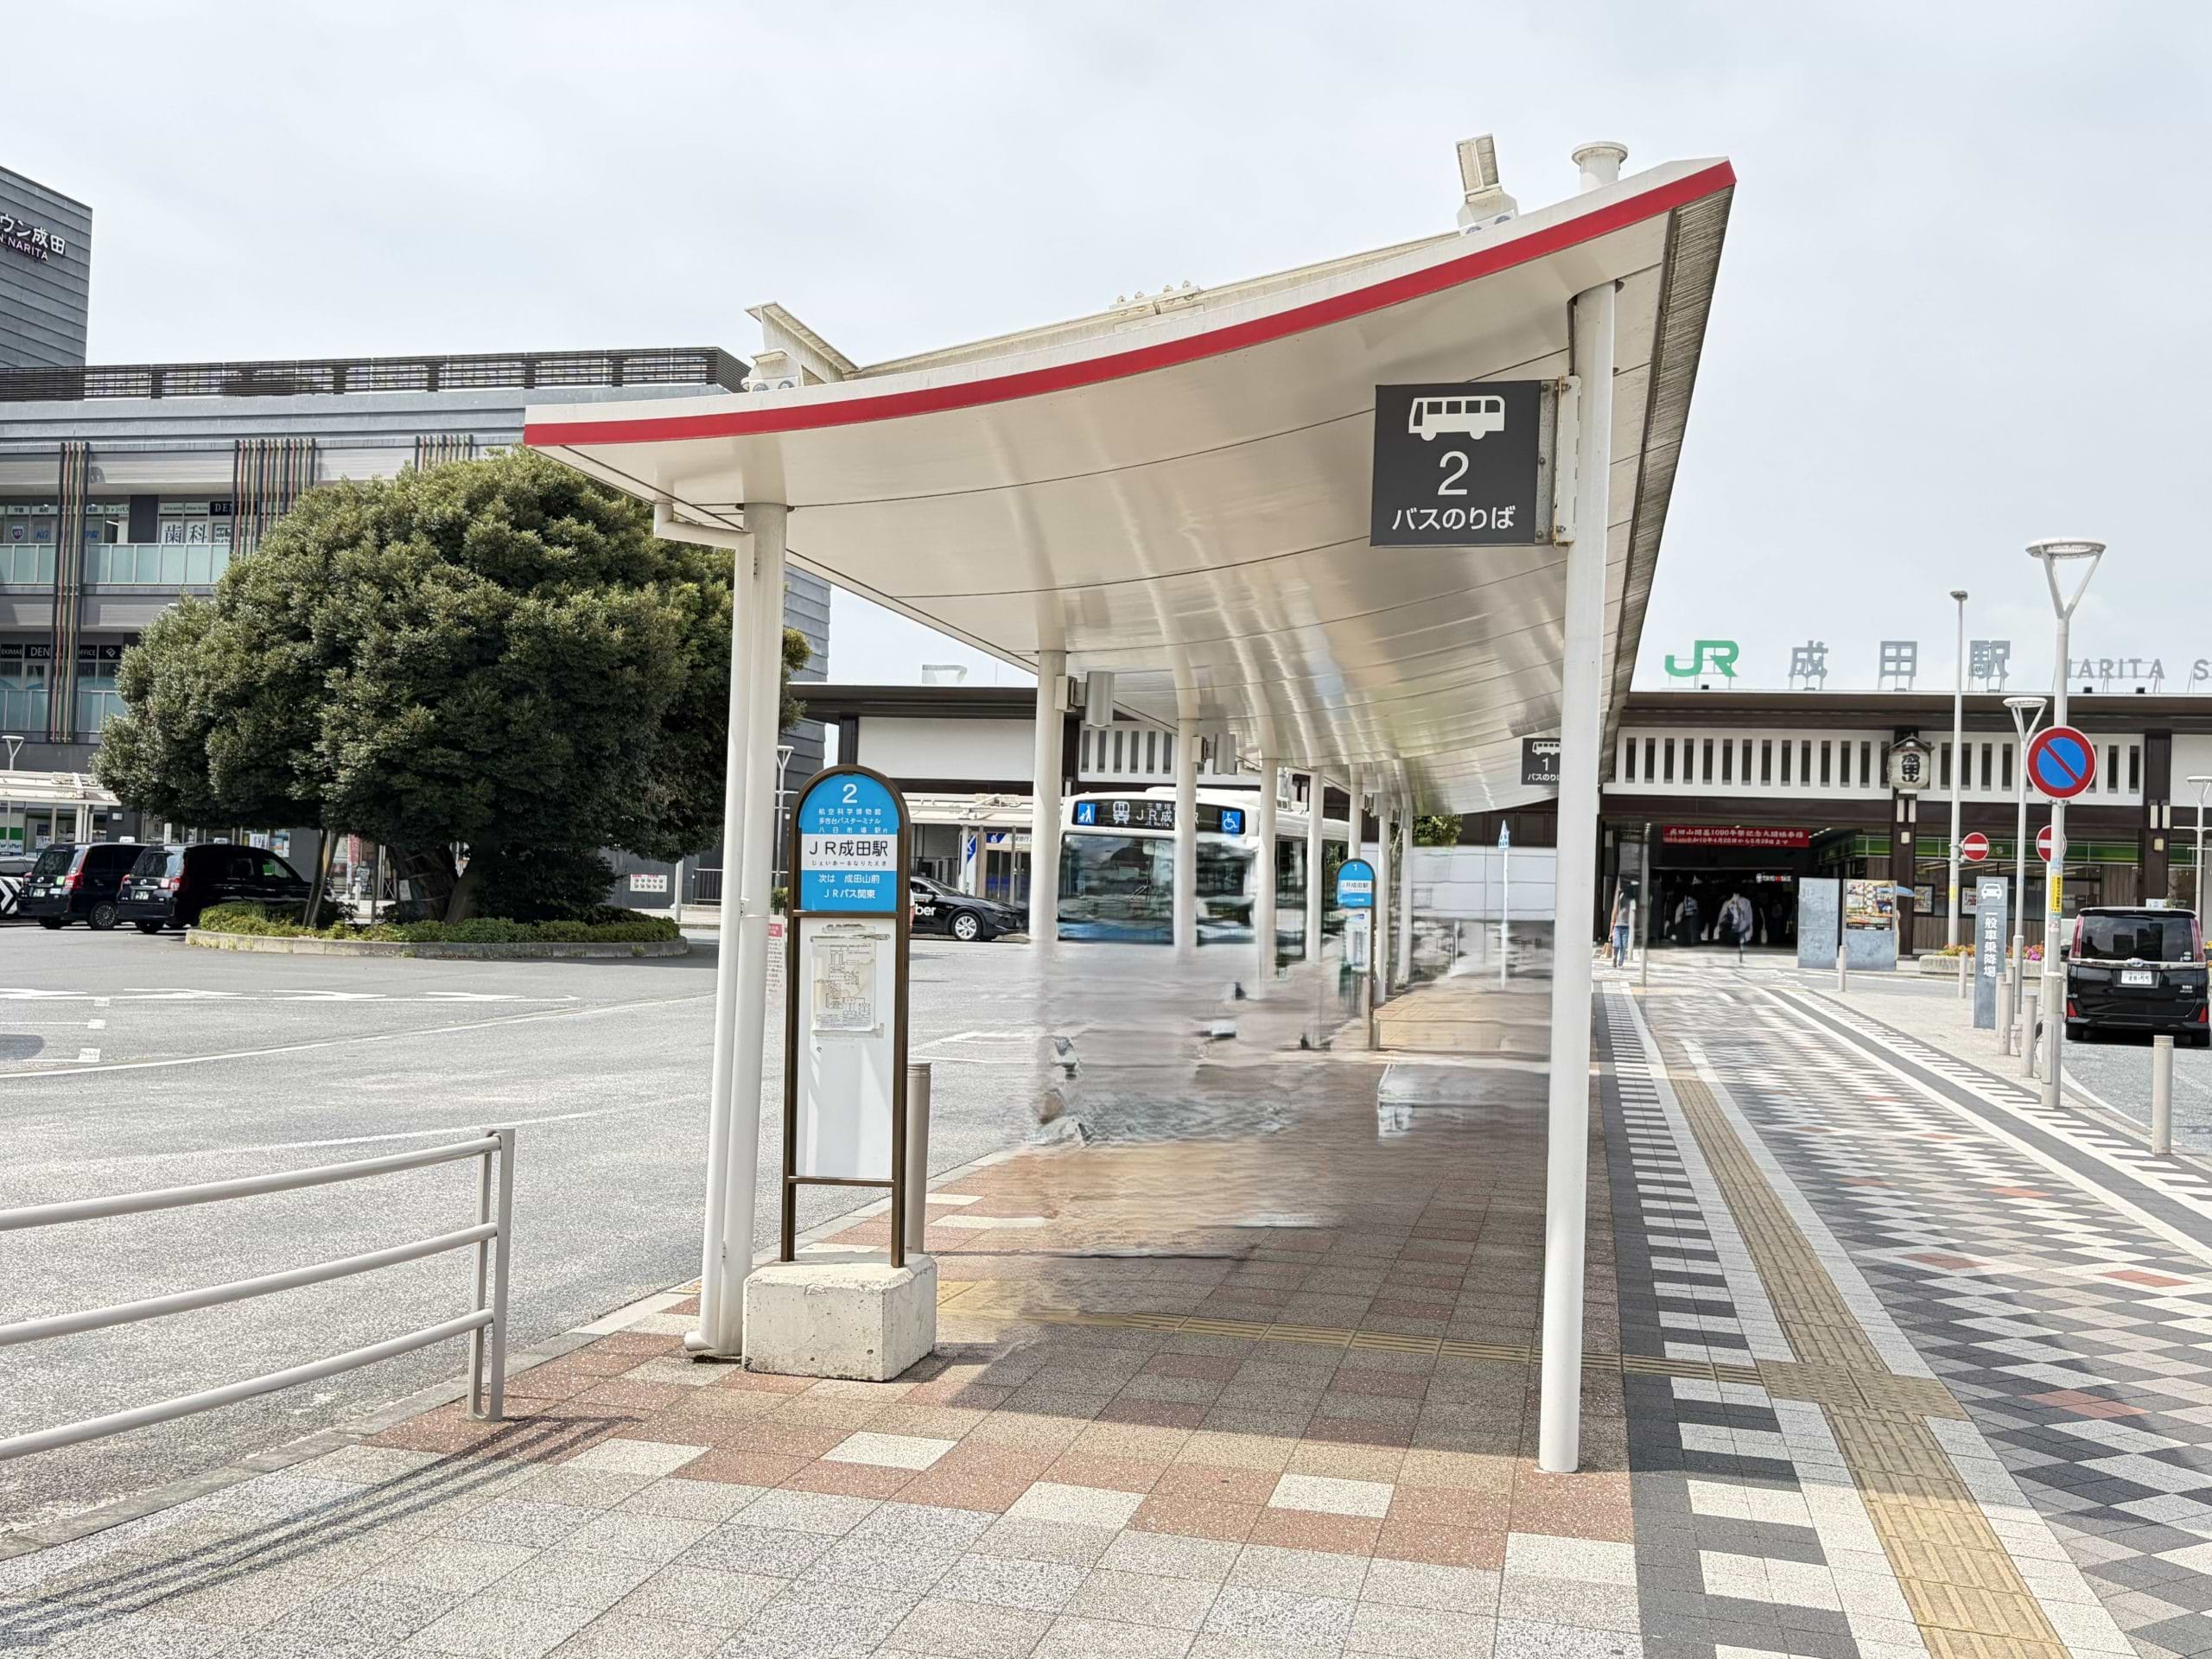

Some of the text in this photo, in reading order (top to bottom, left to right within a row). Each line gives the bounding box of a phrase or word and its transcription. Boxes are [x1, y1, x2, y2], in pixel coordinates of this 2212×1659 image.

[8, 237, 48, 261] NARITA
[1438, 450, 1469, 496] 2
[1392, 505, 1516, 531] バスのりば
[164, 524, 207, 543] 歯科
[1664, 639, 1739, 678] JR
[1541, 757, 1549, 772] 1
[1902, 753, 1920, 783] 成田山
[842, 783, 858, 804] 2
[810, 840, 888, 856] JR成田駅
[818, 874, 880, 884] 次は 成田山前
[824, 889, 876, 899] JRバス関東
[915, 906, 937, 916] ber
[1984, 912, 1998, 977] 一般車乗降場
